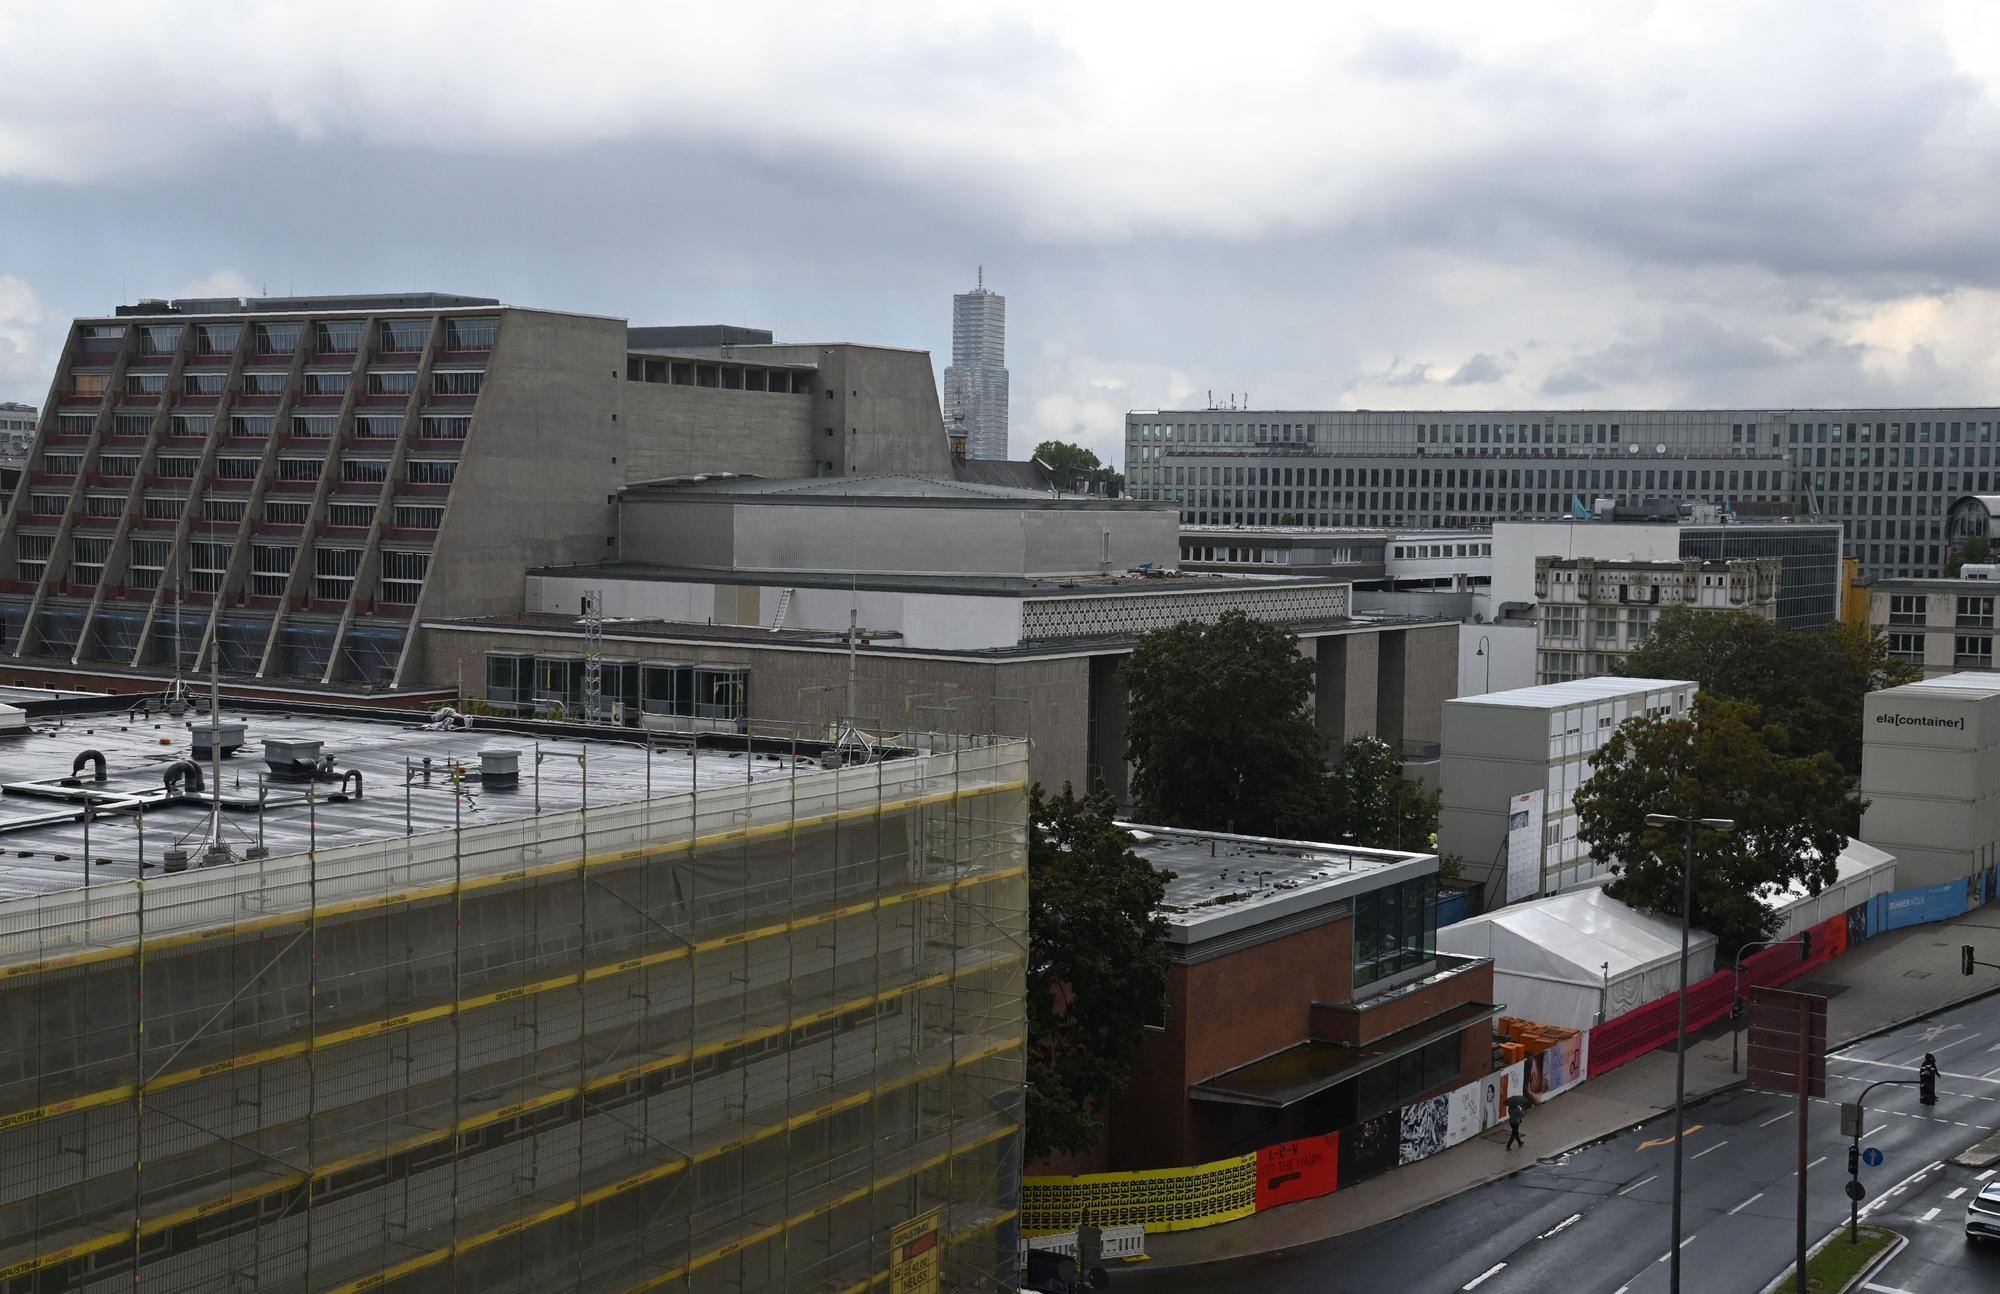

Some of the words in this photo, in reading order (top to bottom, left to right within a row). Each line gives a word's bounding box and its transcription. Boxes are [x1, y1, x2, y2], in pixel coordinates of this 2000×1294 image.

[1876, 714, 1964, 730] ela[container]
[1147, 1179, 1156, 1203] EVER
[1156, 1179, 1165, 1202] EVER
[1166, 1178, 1175, 1202] EVER
[1175, 1177, 1184, 1200] EVER
[1184, 1176, 1193, 1200] EVER
[1193, 1175, 1201, 1198] EVER
[1201, 1173, 1209, 1197] EVER
[1209, 1172, 1217, 1195] EVER
[1224, 1168, 1232, 1192] EVER
[1023, 1186, 1032, 1209] EVER
[1032, 1186, 1041, 1209] EVER
[1042, 1186, 1051, 1209] EVER
[1052, 1186, 1061, 1209] EVER
[1062, 1186, 1071, 1209] EVER
[1072, 1185, 1081, 1208] EVER
[1091, 1183, 1100, 1207] EVER
[1101, 1183, 1110, 1206] EVER
[1111, 1182, 1119, 1206] EVER
[1120, 1181, 1129, 1205] EVER
[1130, 1181, 1138, 1204] EVER
[1138, 1180, 1147, 1204] EVER
[1129, 1207, 1137, 1224] AND
[1138, 1207, 1146, 1223] AND
[1147, 1205, 1155, 1222] AND
[1156, 1205, 1164, 1222] AND
[1165, 1204, 1174, 1221] AND
[1175, 1203, 1183, 1220] AND
[1184, 1202, 1192, 1219] AND
[1216, 1196, 1224, 1213] AND
[1022, 1212, 1031, 1230] AND
[1031, 1212, 1040, 1230] AND
[1041, 1212, 1050, 1230] AND
[1051, 1212, 1060, 1229] AND
[1061, 1212, 1070, 1229] AND
[1091, 1210, 1099, 1226] AND
[1100, 1209, 1109, 1226] AND
[1110, 1208, 1118, 1225] AND
[1119, 1208, 1128, 1225] AND
